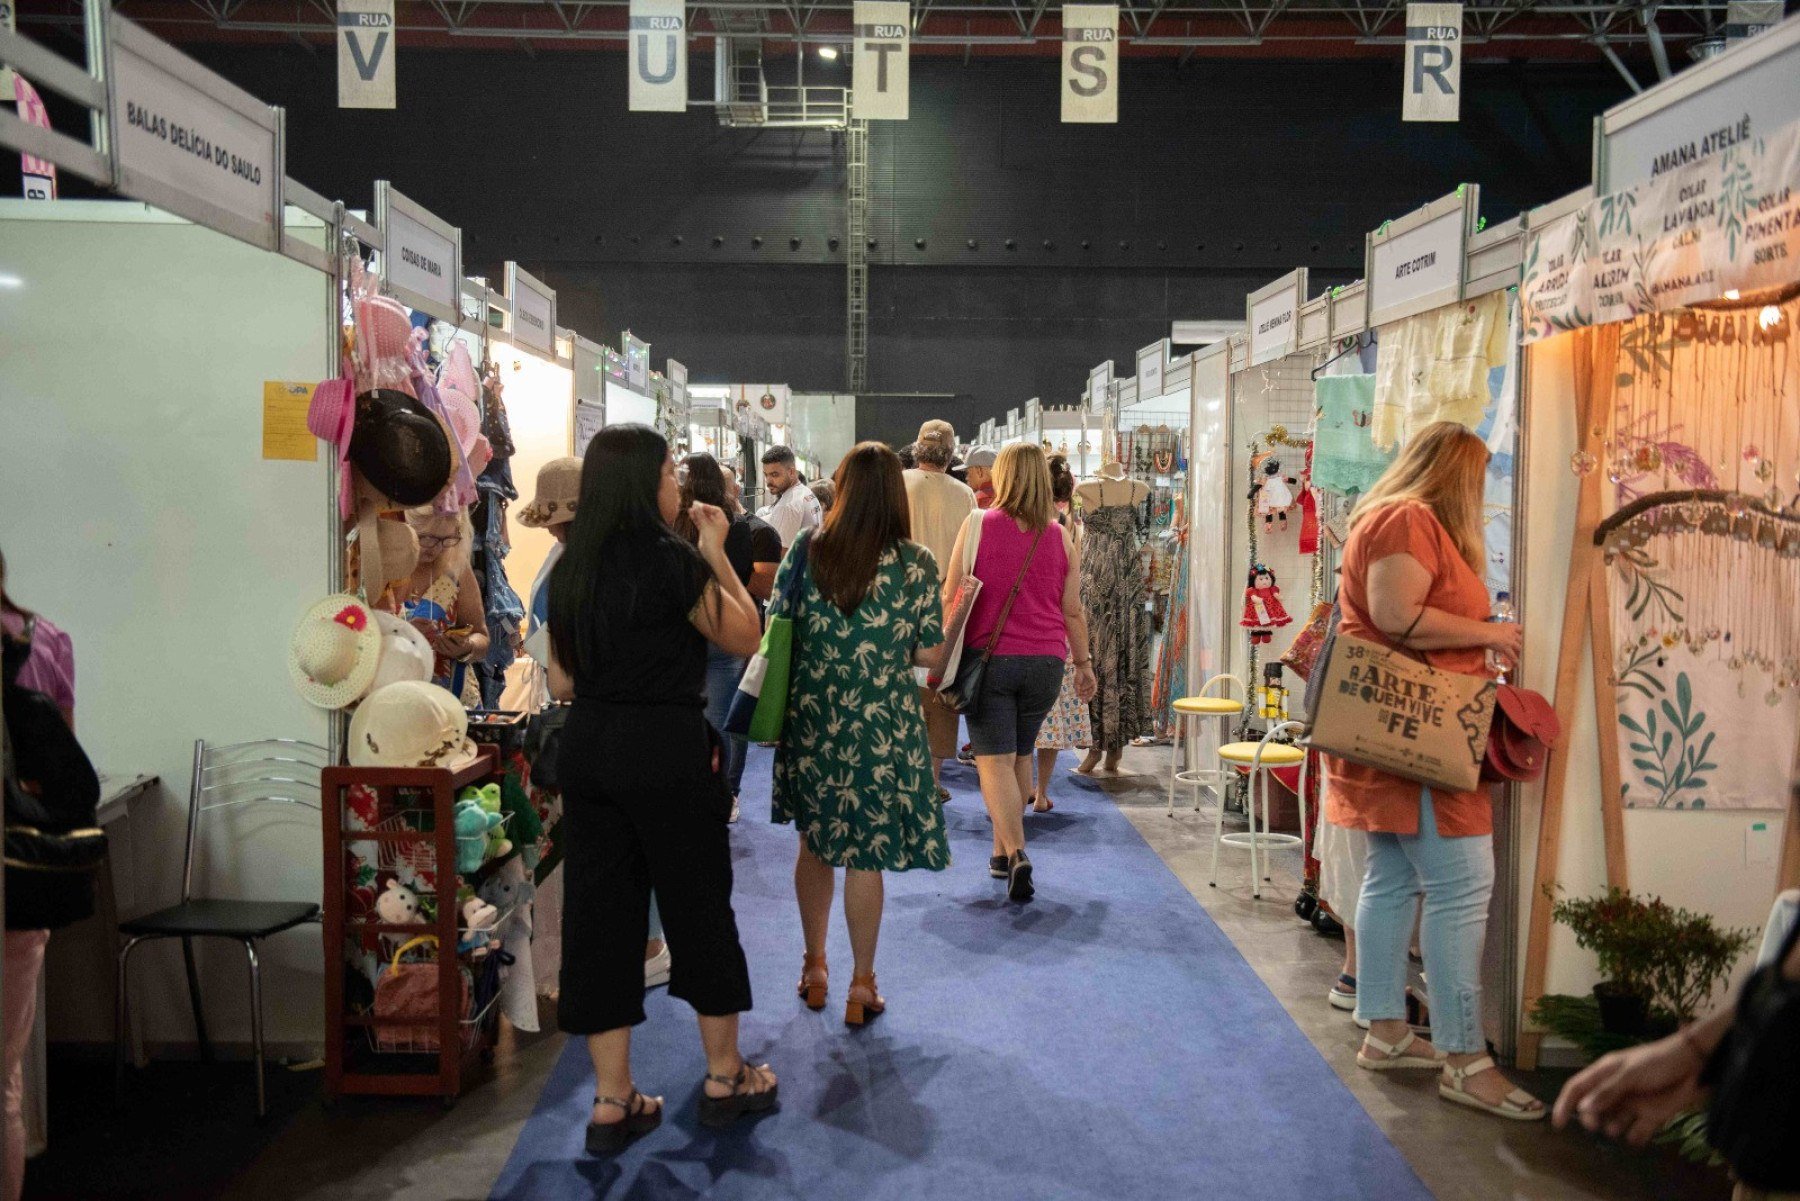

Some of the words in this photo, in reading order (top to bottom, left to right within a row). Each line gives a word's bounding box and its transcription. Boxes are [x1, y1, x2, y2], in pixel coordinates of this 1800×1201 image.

[358, 14, 389, 26] RUA
[650, 17, 681, 29] RUA
[874, 25, 904, 38] RUA
[1083, 28, 1113, 41] RUA
[1427, 27, 1457, 40] RUA
[344, 31, 389, 81] V
[638, 35, 677, 85] U
[865, 43, 901, 93] T
[1069, 46, 1108, 97] S
[1412, 45, 1455, 94] R
[127, 101, 167, 140] BALAS
[170, 122, 212, 163] DELÍCIA
[215, 146, 229, 170] DO
[231, 154, 261, 185] SAULO
[1651, 141, 1697, 178] AMANA
[401, 246, 420, 268] COISAS
[421, 255, 427, 271] DE
[427, 259, 441, 278] MARIA
[1395, 261, 1411, 280] ARTE
[1412, 251, 1436, 273] COTRIM
[1338, 680, 1358, 696] DE
[1360, 685, 1406, 710] QUEM
[1360, 665, 1437, 705] ARTE
